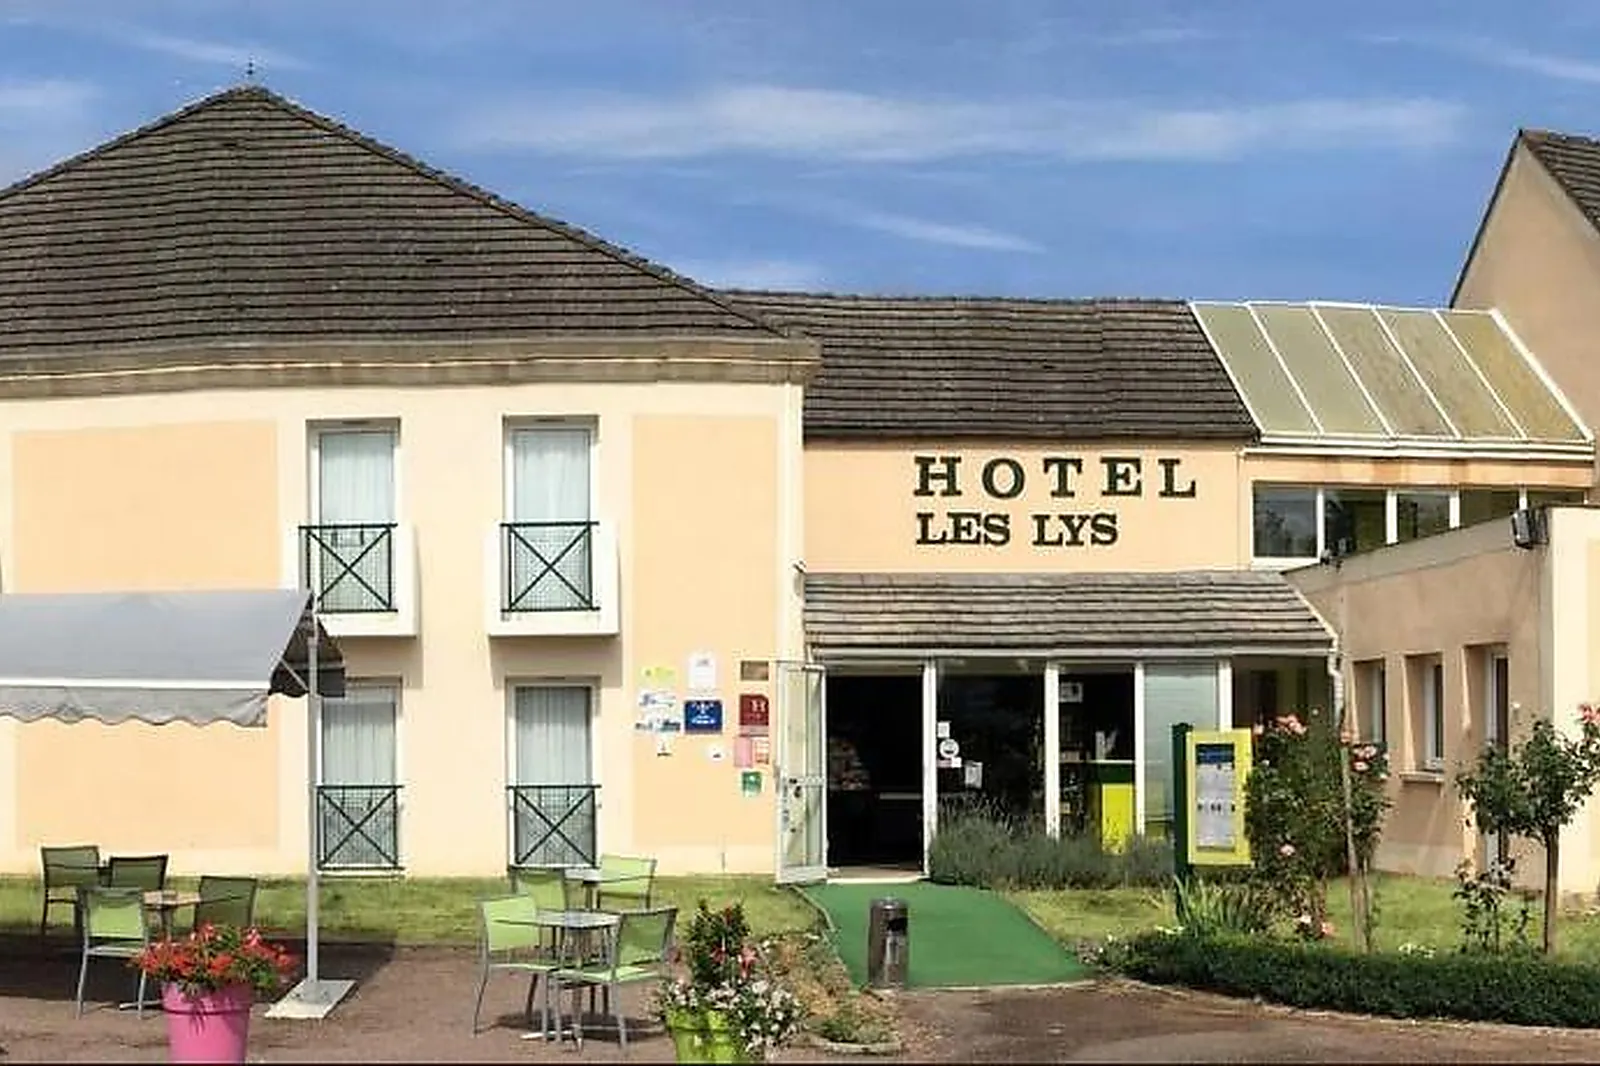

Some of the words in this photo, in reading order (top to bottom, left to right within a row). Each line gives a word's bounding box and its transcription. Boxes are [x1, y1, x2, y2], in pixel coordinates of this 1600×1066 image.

[914, 456, 1196, 498] HOTEL
[916, 512, 1010, 545] LES
[1032, 513, 1118, 546] LYS
